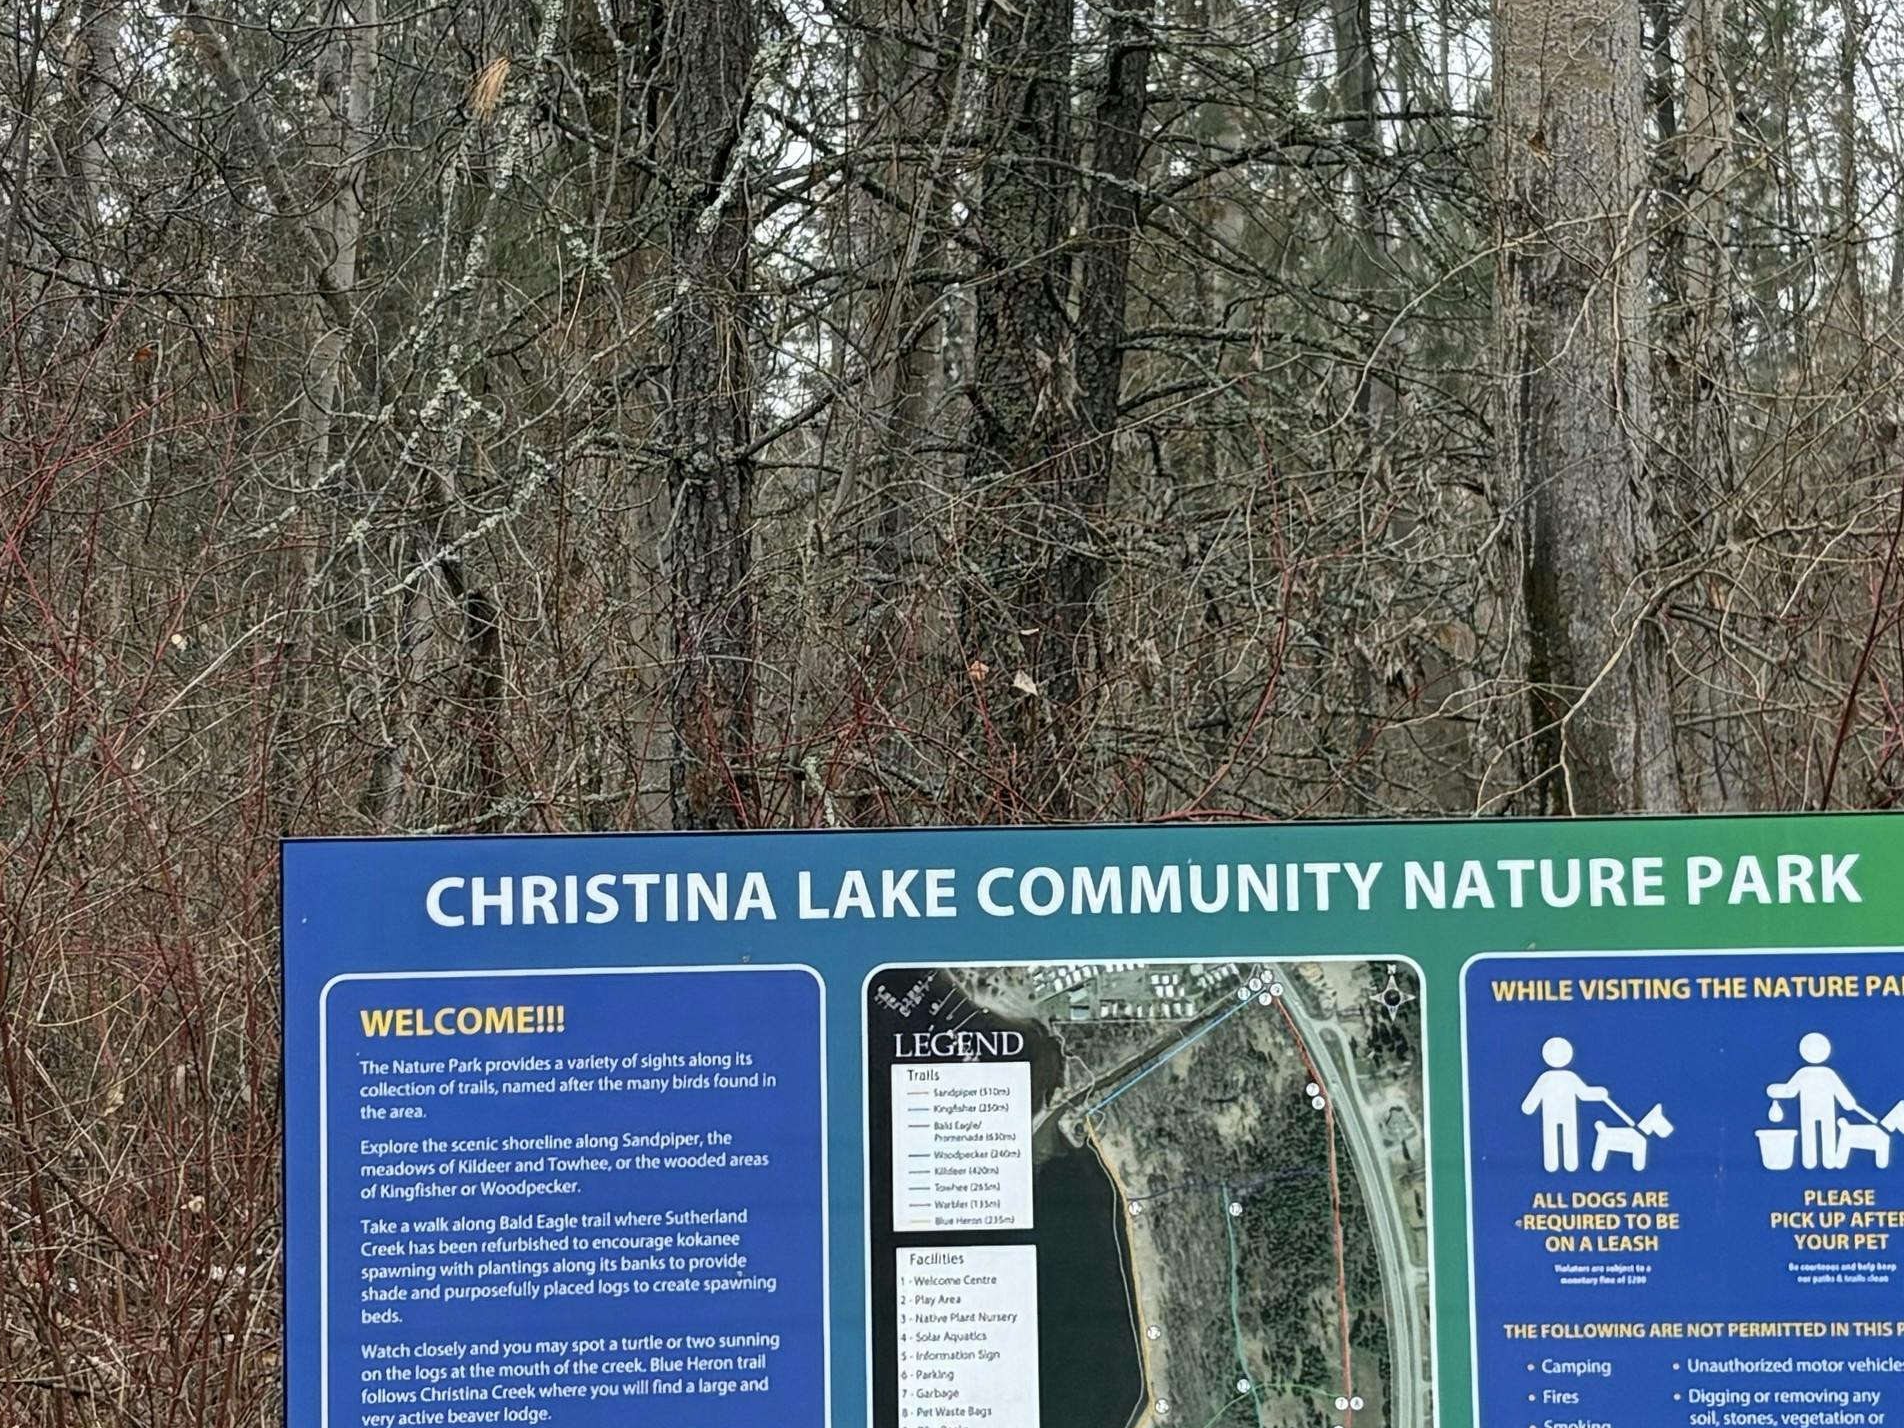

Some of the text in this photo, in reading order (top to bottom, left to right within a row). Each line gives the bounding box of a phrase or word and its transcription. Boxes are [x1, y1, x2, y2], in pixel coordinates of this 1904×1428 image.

[426, 854, 1862, 927] CHRISTINA LAKE COMMUNITY NATURE PARK
[1492, 980, 1572, 1001] WHILE
[1579, 978, 1690, 1000] VISITING
[1696, 978, 1746, 998] THE
[1754, 976, 1859, 998] NATURE
[360, 1006, 564, 1037] WELCOME!!!
[894, 1031, 1025, 1058] LEGEND
[359, 1052, 752, 1075] The Nature Park provides a variety of sights along its
[907, 1069, 940, 1081] Trails
[360, 1072, 776, 1097] collection of trails, named after the many birds found in
[360, 1104, 426, 1119] the area.
[361, 1130, 732, 1157] Explore the scenic shoreline along Sandpiper, the
[361, 1152, 769, 1176] meadows of Kildeer and Towhee, or the wooded areas
[360, 1179, 581, 1199] of Kingfisher or Woodpecker.
[1533, 1192, 1668, 1208] ALL DOGS ARE
[1804, 1190, 1874, 1206] PLEASE
[1524, 1214, 1678, 1232] REQUIRED TO BE
[1771, 1212, 1814, 1228] PICK
[1819, 1212, 1846, 1228] UP
[1546, 1236, 1658, 1252] ON A LEASH
[1794, 1234, 1888, 1250] YOUR PET
[910, 1252, 964, 1265] Facilities
[914, 1274, 997, 1286] Welcome Centre
[915, 1294, 961, 1307] Play Area
[362, 1308, 402, 1324] beds.
[916, 1331, 987, 1343] Solar Aquatics
[1504, 1324, 1537, 1338] THE
[1541, 1324, 1646, 1338] FOLLOWING
[1650, 1323, 1682, 1337] ARE
[1687, 1323, 1724, 1337] NOT
[1728, 1322, 1827, 1337] PERMITTED
[1831, 1322, 1849, 1336] IN
[1853, 1322, 1893, 1336] THIS
[916, 1349, 1000, 1362] Information Sign
[1542, 1358, 1611, 1377] Camping
[1688, 1358, 1793, 1373] Unauthorized
[1796, 1359, 1844, 1372] motor
[916, 1369, 954, 1382] Parking
[916, 1388, 959, 1400] Garbage
[1543, 1390, 1579, 1404] Fires
[1688, 1388, 1880, 1407] Digging or removing any
[916, 1406, 992, 1418] Pet Waste Bags
[1690, 1410, 1885, 1428] soil, stones, vegetation or
